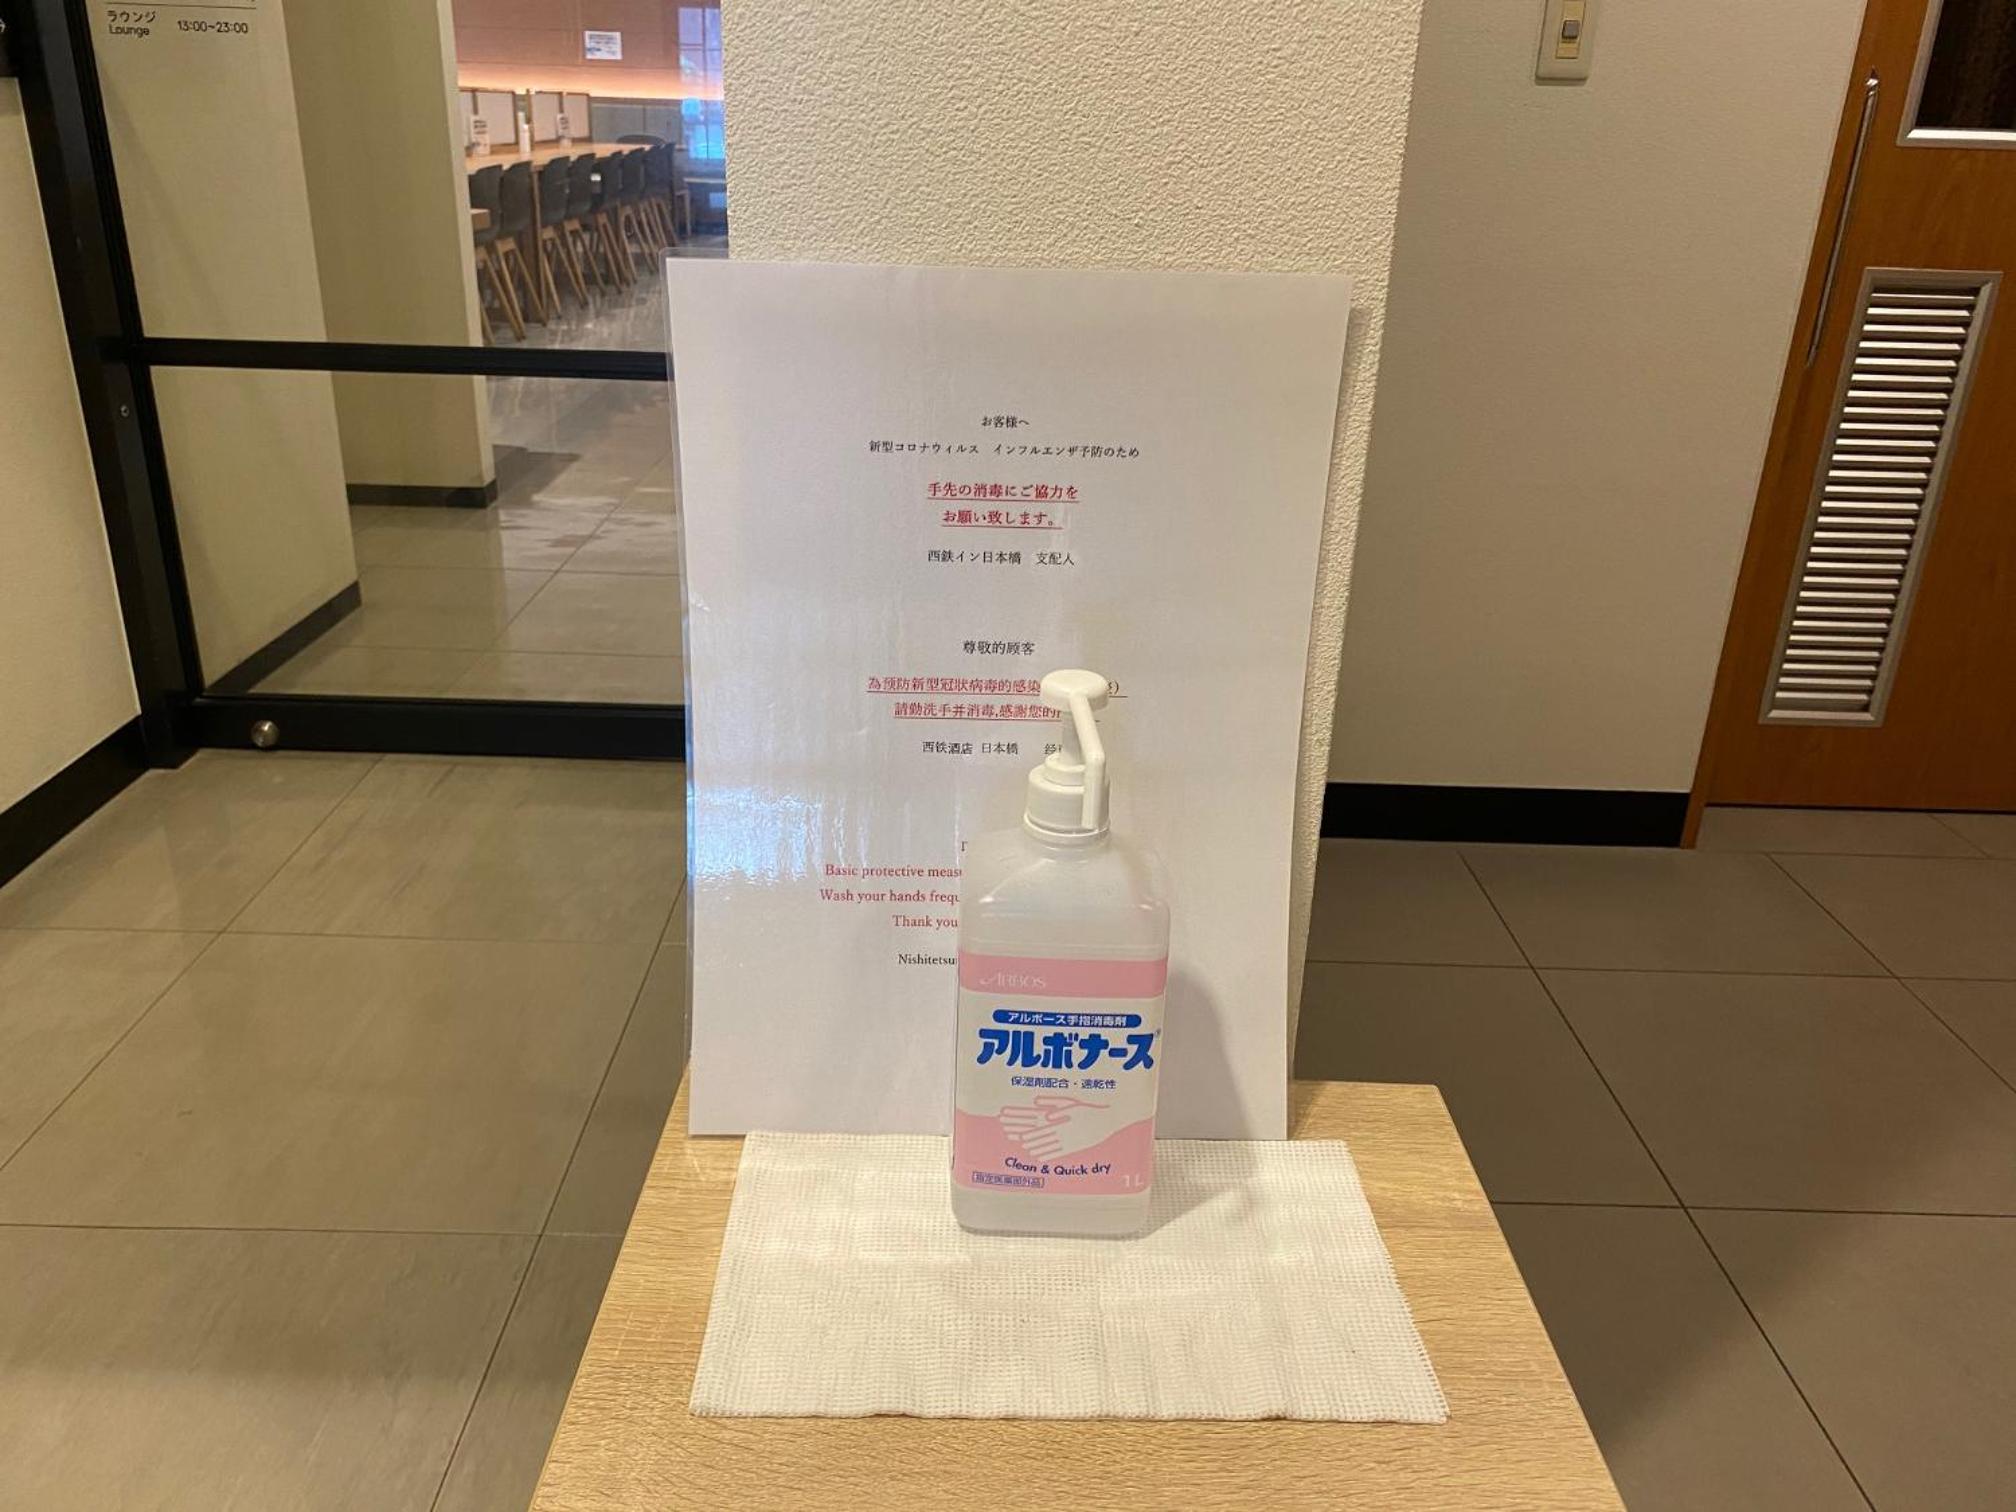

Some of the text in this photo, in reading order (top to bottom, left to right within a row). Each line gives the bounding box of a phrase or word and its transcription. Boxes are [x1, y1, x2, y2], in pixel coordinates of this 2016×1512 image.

[107, 10, 156, 24] ラウンジ
[109, 25, 150, 38] Lounge
[981, 415, 1030, 429] お客様へ
[993, 444, 1140, 459] インフルエンザ予防のため
[927, 482, 1079, 499] 手先の消毒にご協力を
[942, 509, 1055, 527] お願い致します。
[928, 549, 1075, 566] 西鉄イン日本橋 支配人
[825, 863, 857, 877] Basic
[862, 864, 924, 879] protective
[820, 888, 853, 902] Wash
[858, 890, 885, 904] your
[889, 889, 926, 903] hands
[892, 914, 958, 931] Thank you
[898, 953, 956, 966] Nishitetsu
[977, 1028, 1155, 1071] アルボナース
[1004, 1156, 1112, 1176] Clean & Quick dry
